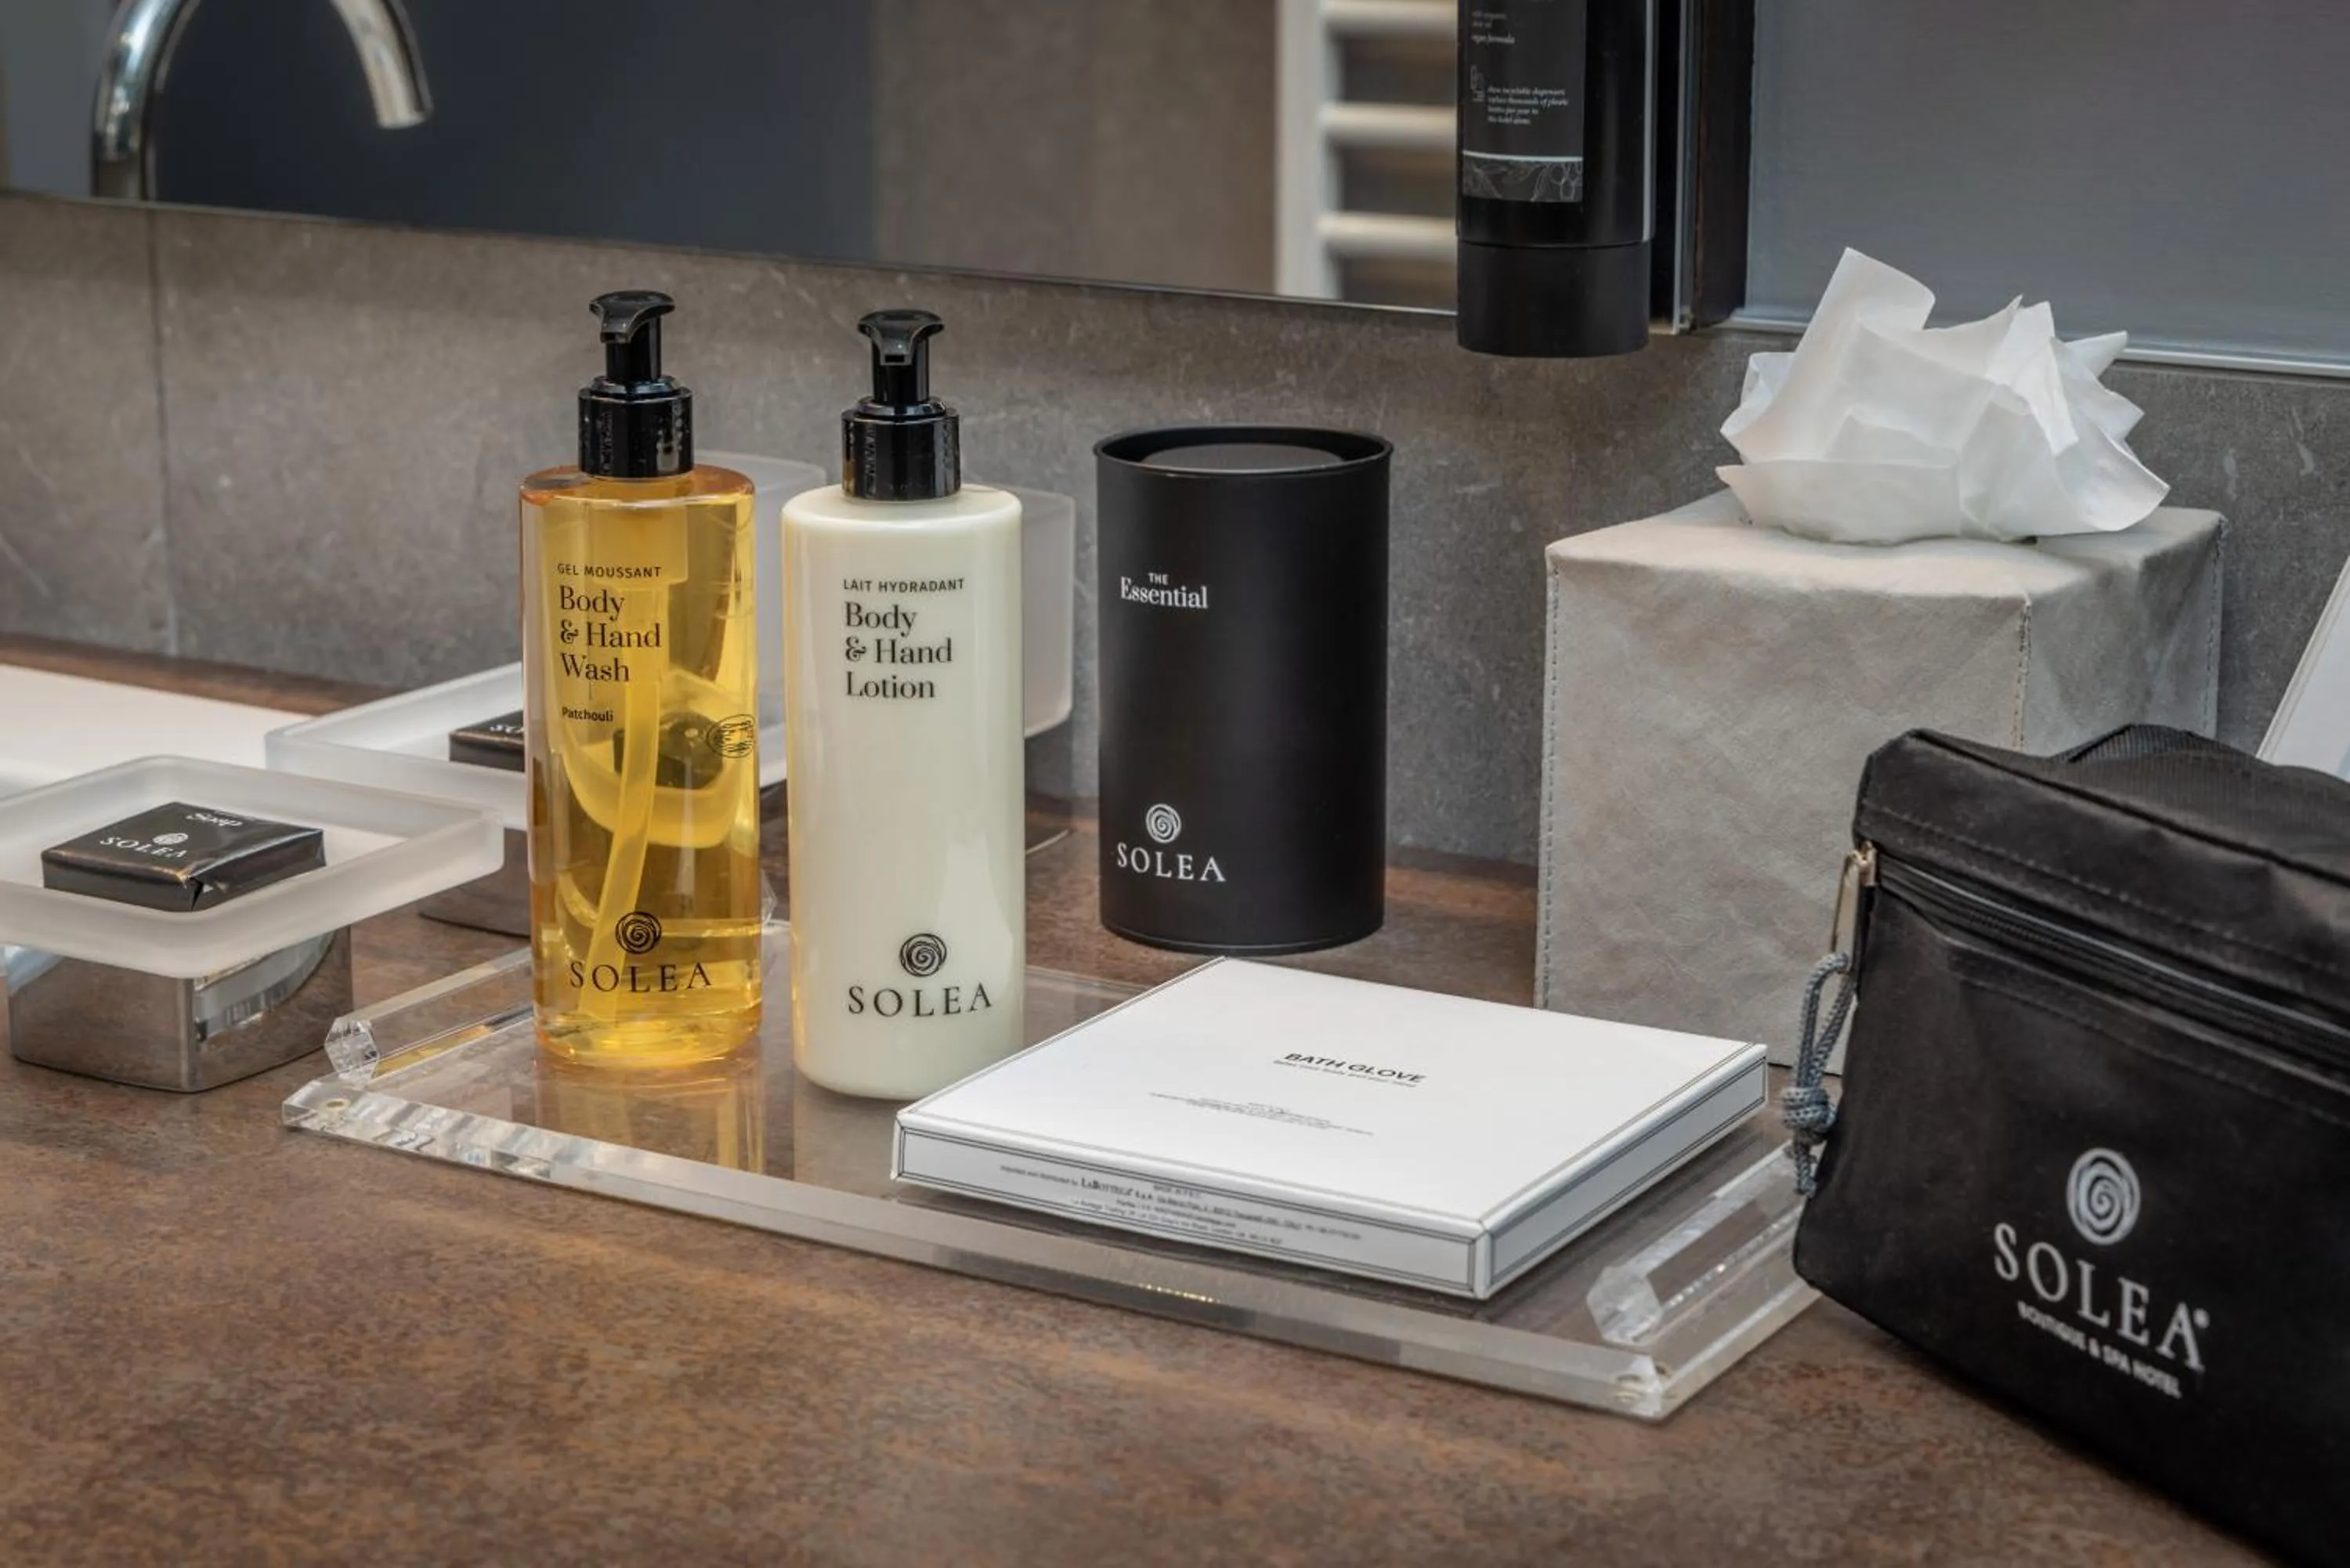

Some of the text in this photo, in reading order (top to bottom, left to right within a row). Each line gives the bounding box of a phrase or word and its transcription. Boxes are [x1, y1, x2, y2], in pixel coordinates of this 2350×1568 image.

[558, 563, 662, 579] GEL MOUSSANT
[843, 579, 872, 593] LAIT
[1148, 572, 1169, 586] THE
[559, 585, 625, 621] Body
[1120, 576, 1209, 609] Essential
[560, 619, 662, 649] & Hand
[844, 601, 917, 638] Body
[845, 636, 953, 665] & Hand
[560, 652, 630, 683] Wash
[846, 670, 935, 699] Lotion
[561, 706, 614, 722] Patchouli
[99, 835, 188, 858] SOLEA
[1116, 840, 1227, 883] SOLEA
[569, 960, 712, 993] SOLEA
[848, 981, 993, 1017] SOLEA
[1284, 1053, 1347, 1068] BATH
[1347, 1064, 1427, 1083] GLOVE
[1994, 1222, 2206, 1372] SOLEA
[2131, 1358, 2182, 1400] HOTEL
